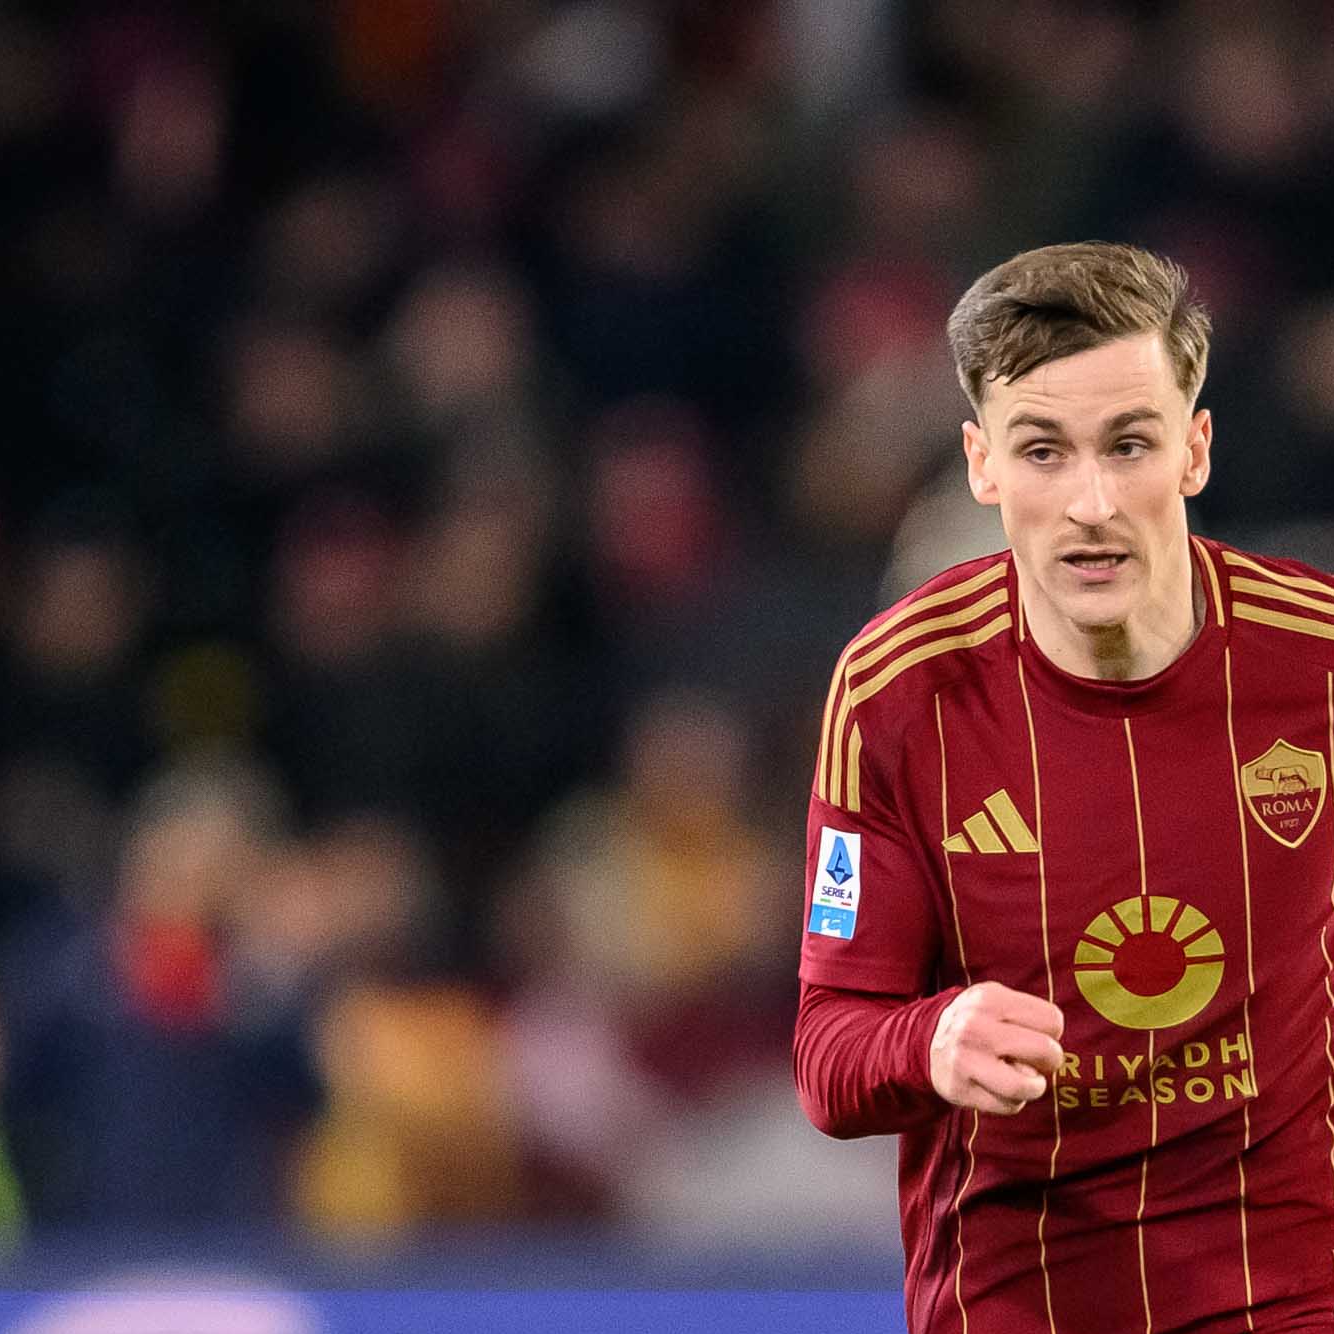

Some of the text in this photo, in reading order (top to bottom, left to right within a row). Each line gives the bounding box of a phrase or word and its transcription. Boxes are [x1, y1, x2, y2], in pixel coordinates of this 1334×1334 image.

[1262, 798, 1313, 816] ROMA
[821, 885, 853, 901] SERIE A
[1058, 1033, 1248, 1081] RIYADH
[1058, 1068, 1253, 1109] SEASON
